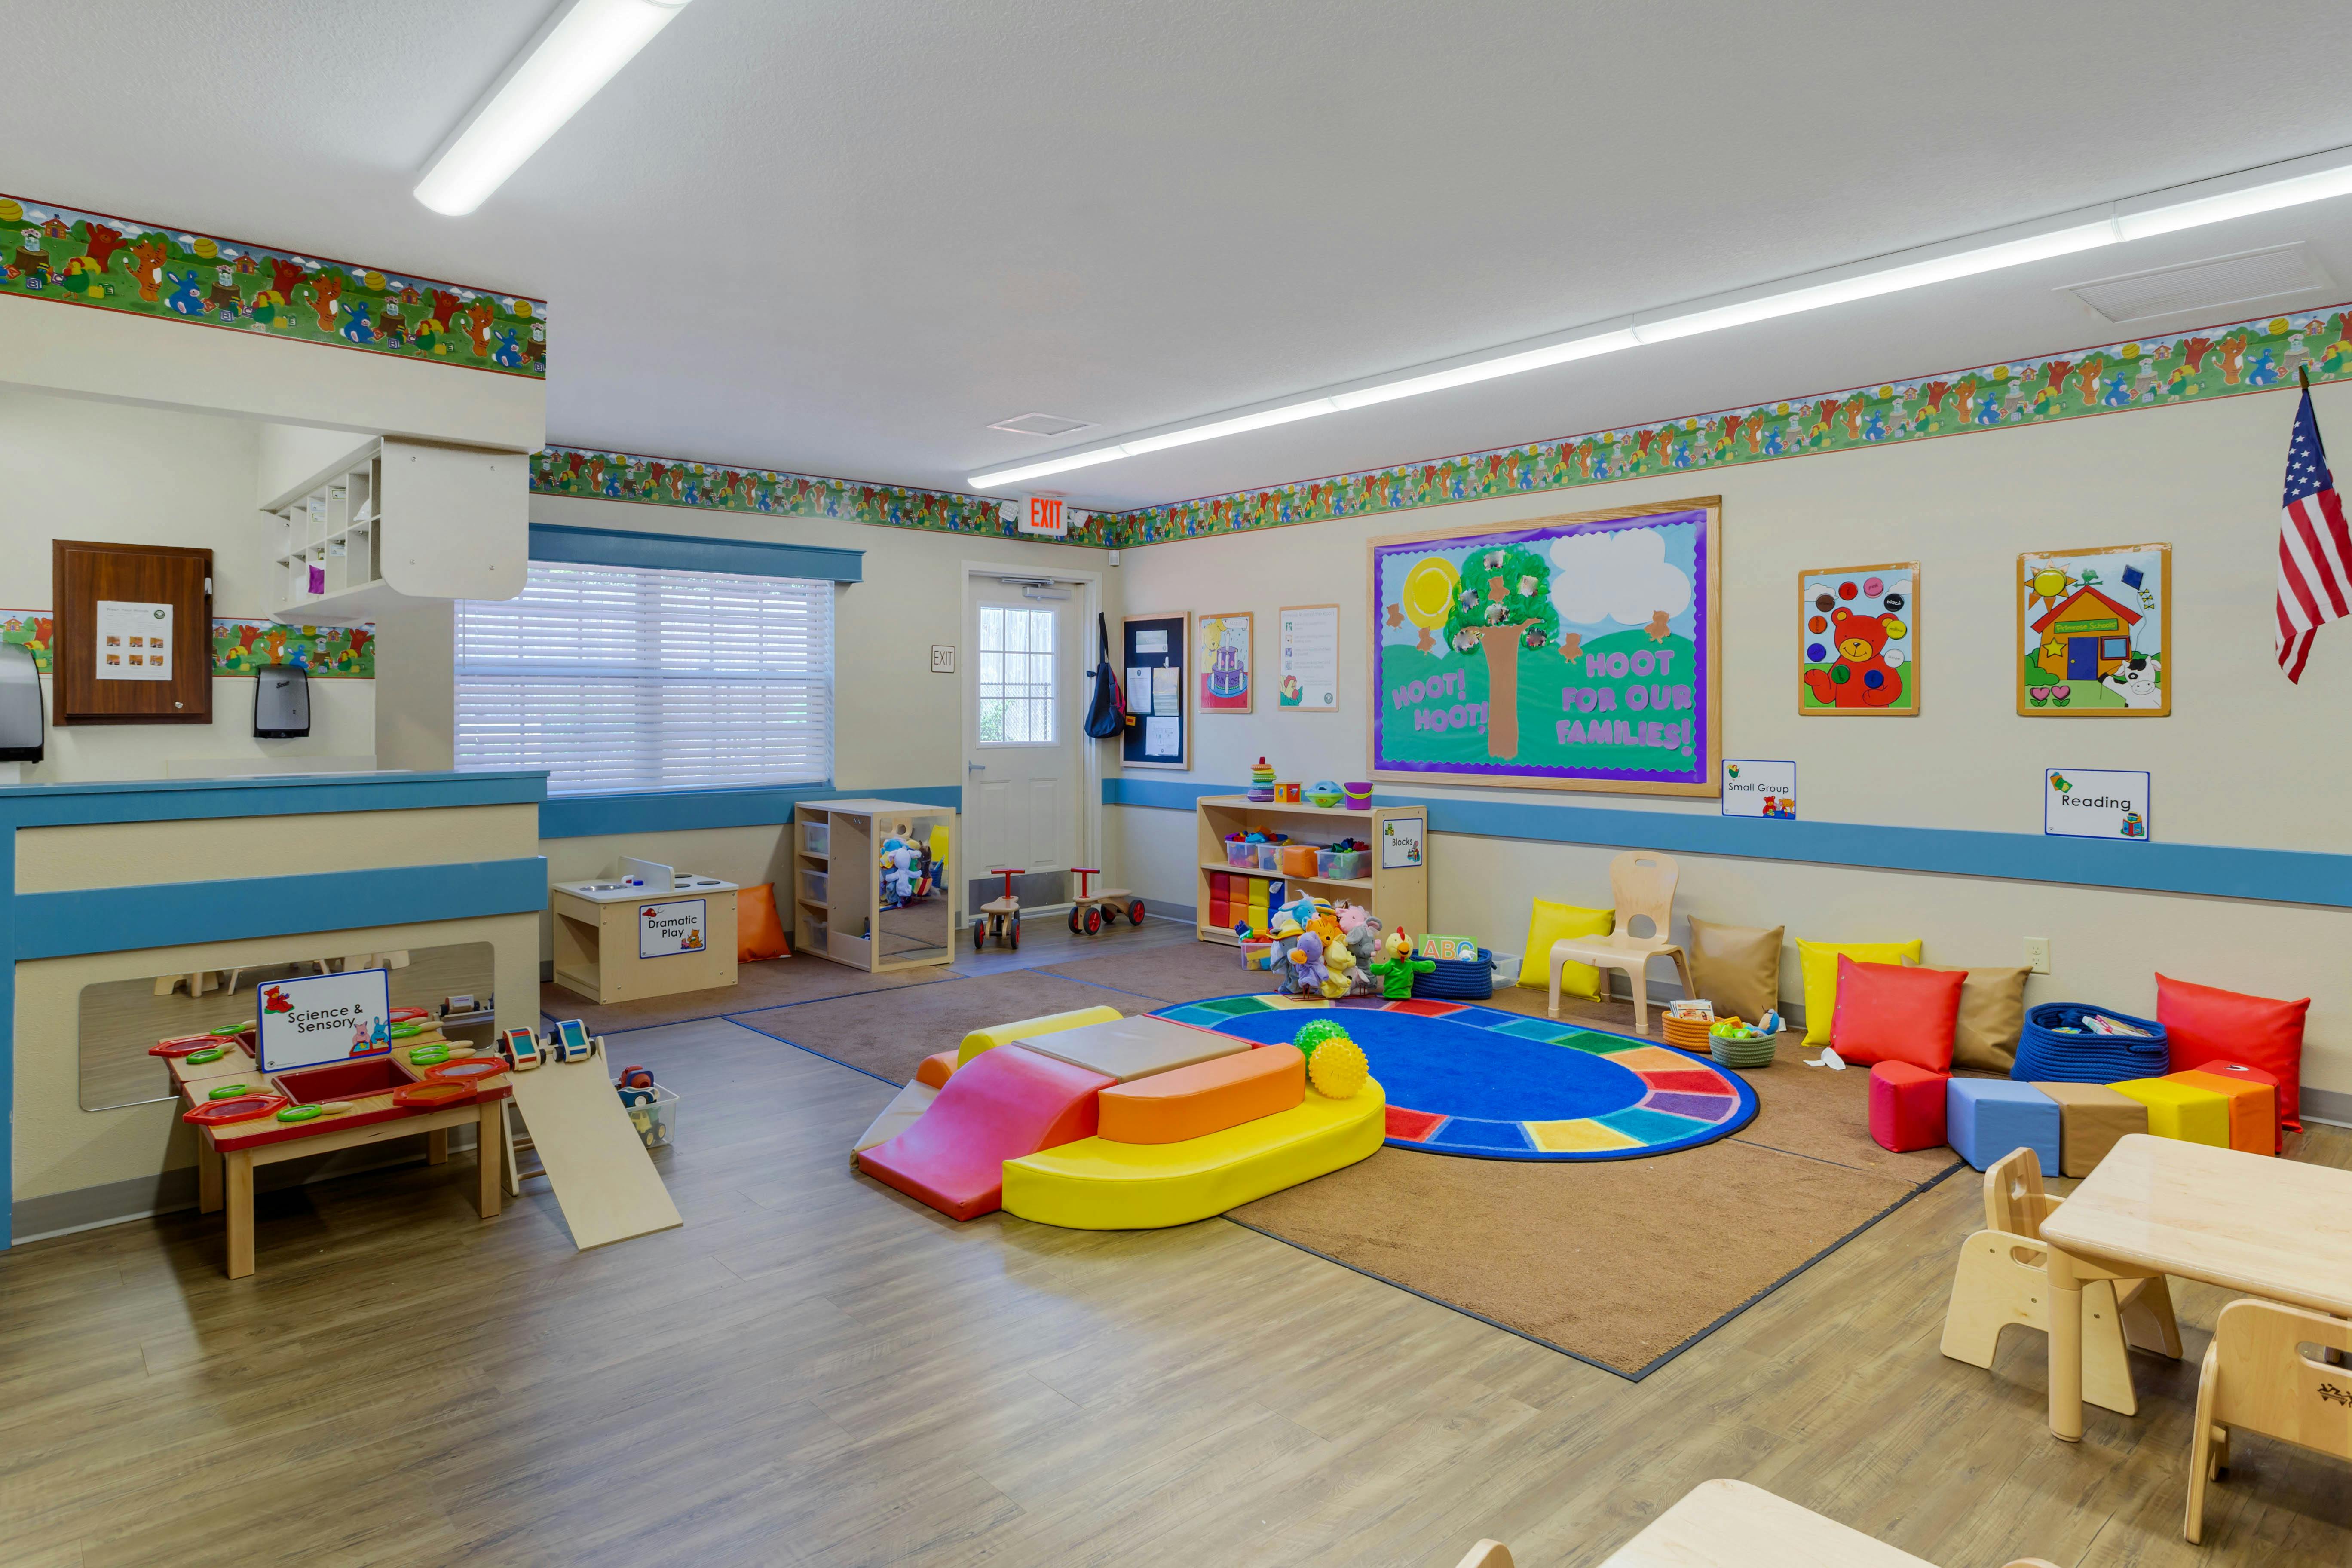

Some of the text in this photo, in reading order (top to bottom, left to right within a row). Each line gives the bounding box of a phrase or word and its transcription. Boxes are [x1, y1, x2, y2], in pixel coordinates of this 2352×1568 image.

[1031, 498, 1063, 529] EXIT
[934, 650, 953, 665] EXIT
[1586, 650, 1675, 678] HOOT
[1392, 668, 1466, 709] HOOT!
[1562, 685, 1692, 712] FOR OUR
[1414, 702, 1488, 735] HOOT!
[1556, 719, 1693, 756] FAMILIES!
[1729, 782, 1789, 795] Small Group
[2062, 794, 2131, 812] Reading
[1392, 837, 1413, 846] Blocks
[648, 915, 697, 929] Dramatic
[662, 928, 685, 938] Play
[288, 1004, 363, 1023] Science &
[297, 1017, 355, 1034] Sensory
